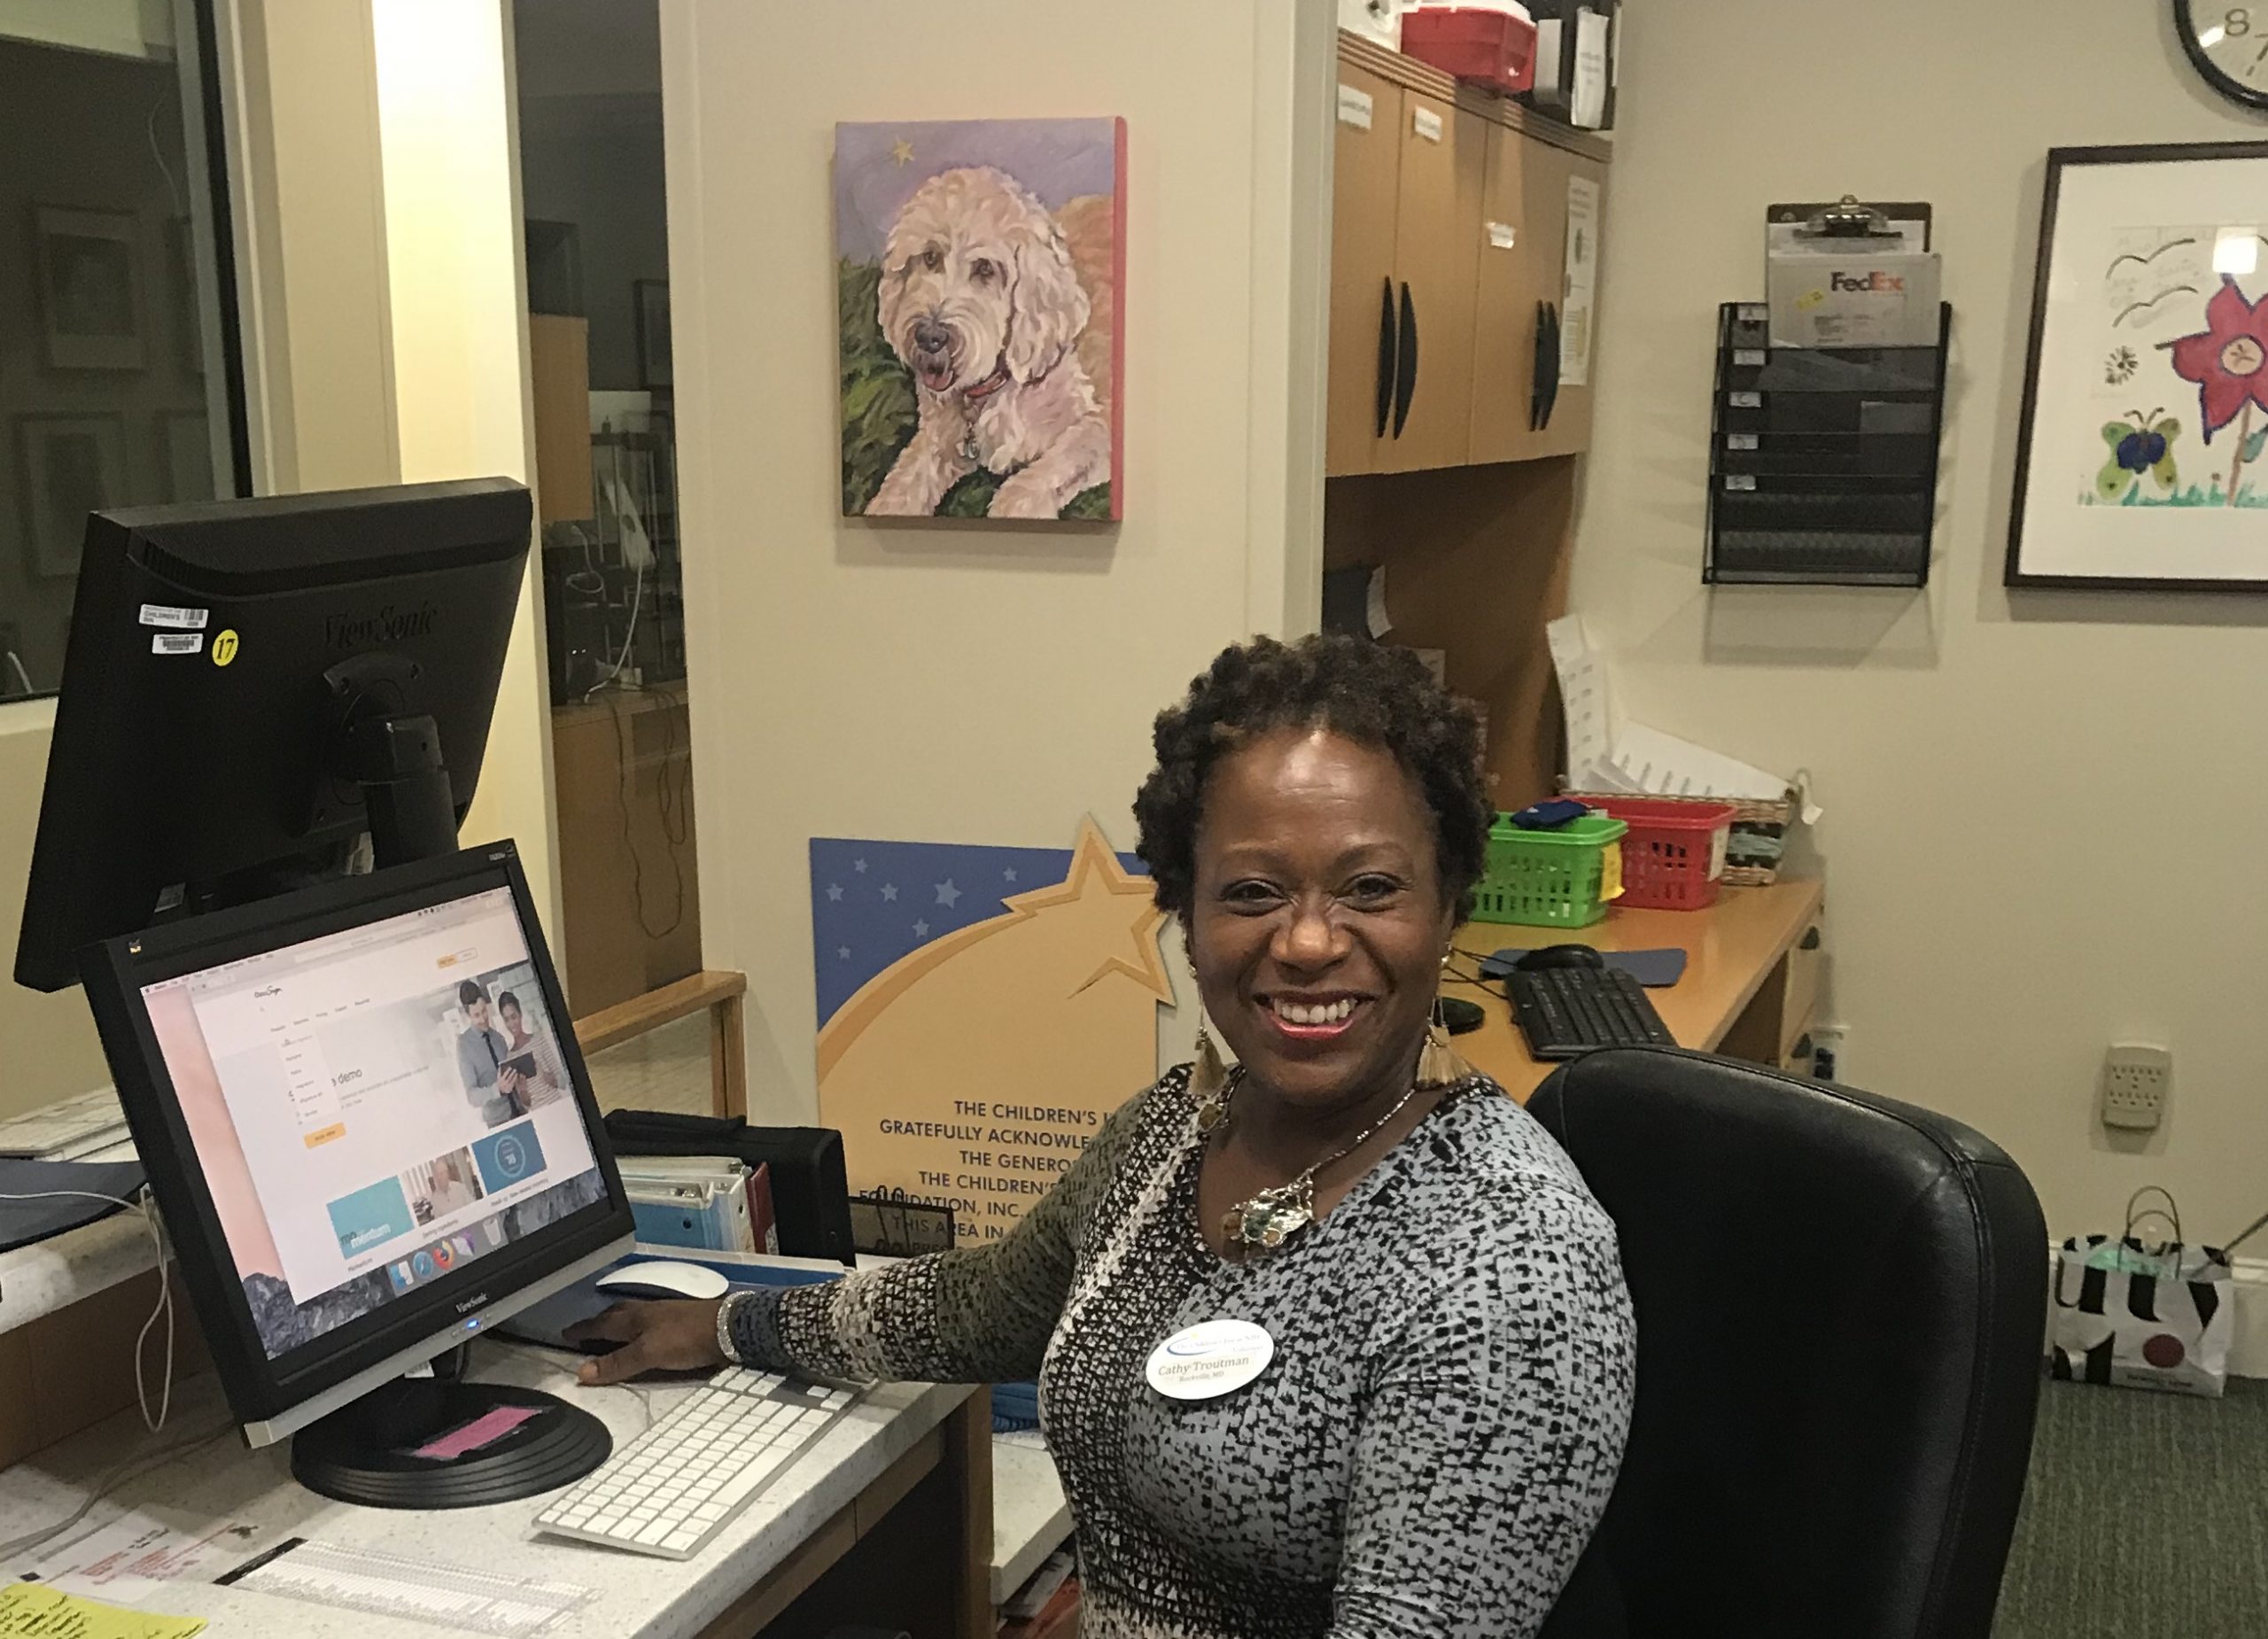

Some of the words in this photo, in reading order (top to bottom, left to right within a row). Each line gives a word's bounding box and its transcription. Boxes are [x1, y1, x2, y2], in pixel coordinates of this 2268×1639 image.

[2225, 8, 2250, 36] 8
[1830, 270, 1904, 292] FedEx
[216, 638, 236, 659] 17
[338, 1068, 362, 1084] demo
[954, 1100, 986, 1116] THE
[992, 1103, 1097, 1126] CHILDREN'S
[880, 1119, 983, 1141] GRATEFULLY
[988, 1129, 1090, 1150] ACKNOWLE
[959, 1150, 991, 1167] THE
[998, 1153, 1077, 1173] GENERO
[919, 1170, 950, 1188] THE
[987, 1203, 1023, 1217] INC.
[893, 1216, 929, 1233] THIS
[985, 1225, 1004, 1239] IN
[455, 1293, 488, 1313] ViewSonic
[1158, 1364, 1192, 1377] Cathy
[1193, 1356, 1249, 1371] Troutman
